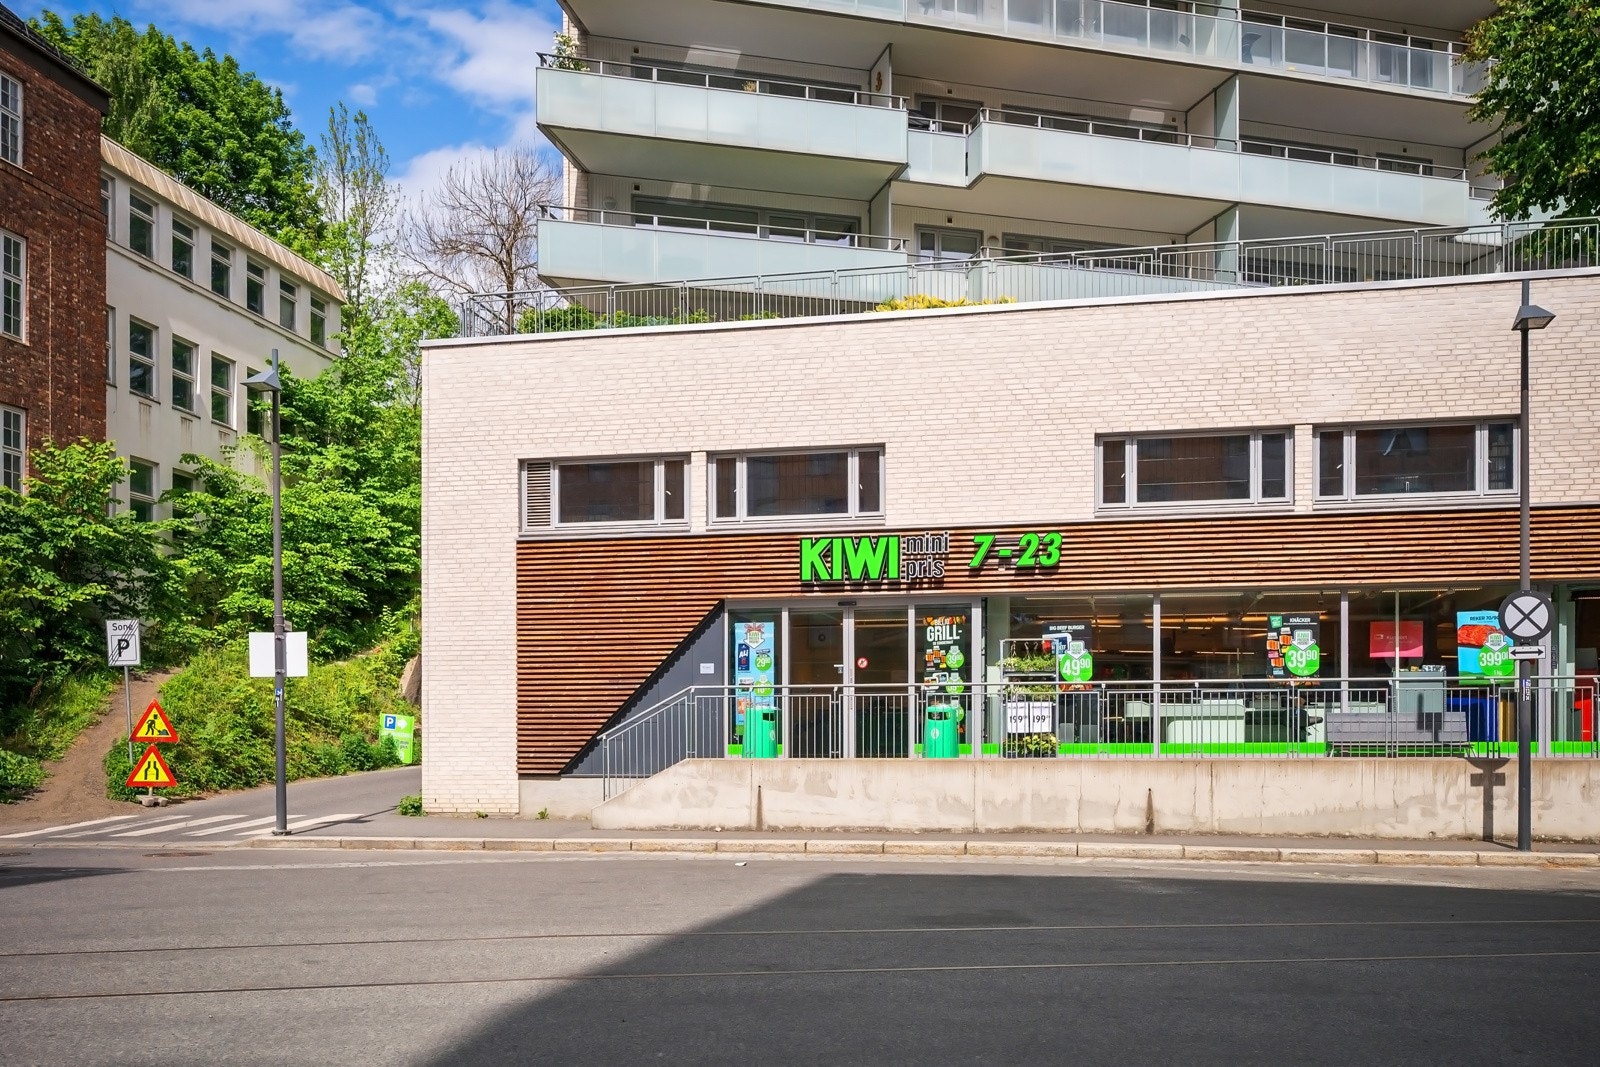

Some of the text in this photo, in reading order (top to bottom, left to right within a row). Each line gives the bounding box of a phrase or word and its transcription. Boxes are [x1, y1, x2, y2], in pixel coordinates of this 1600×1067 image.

[904, 531, 950, 554] mini
[800, 535, 900, 582] KIWI
[904, 555, 945, 581] pris
[926, 624, 962, 642] GRILL-
[117, 638, 130, 658] P
[386, 717, 394, 728] P
